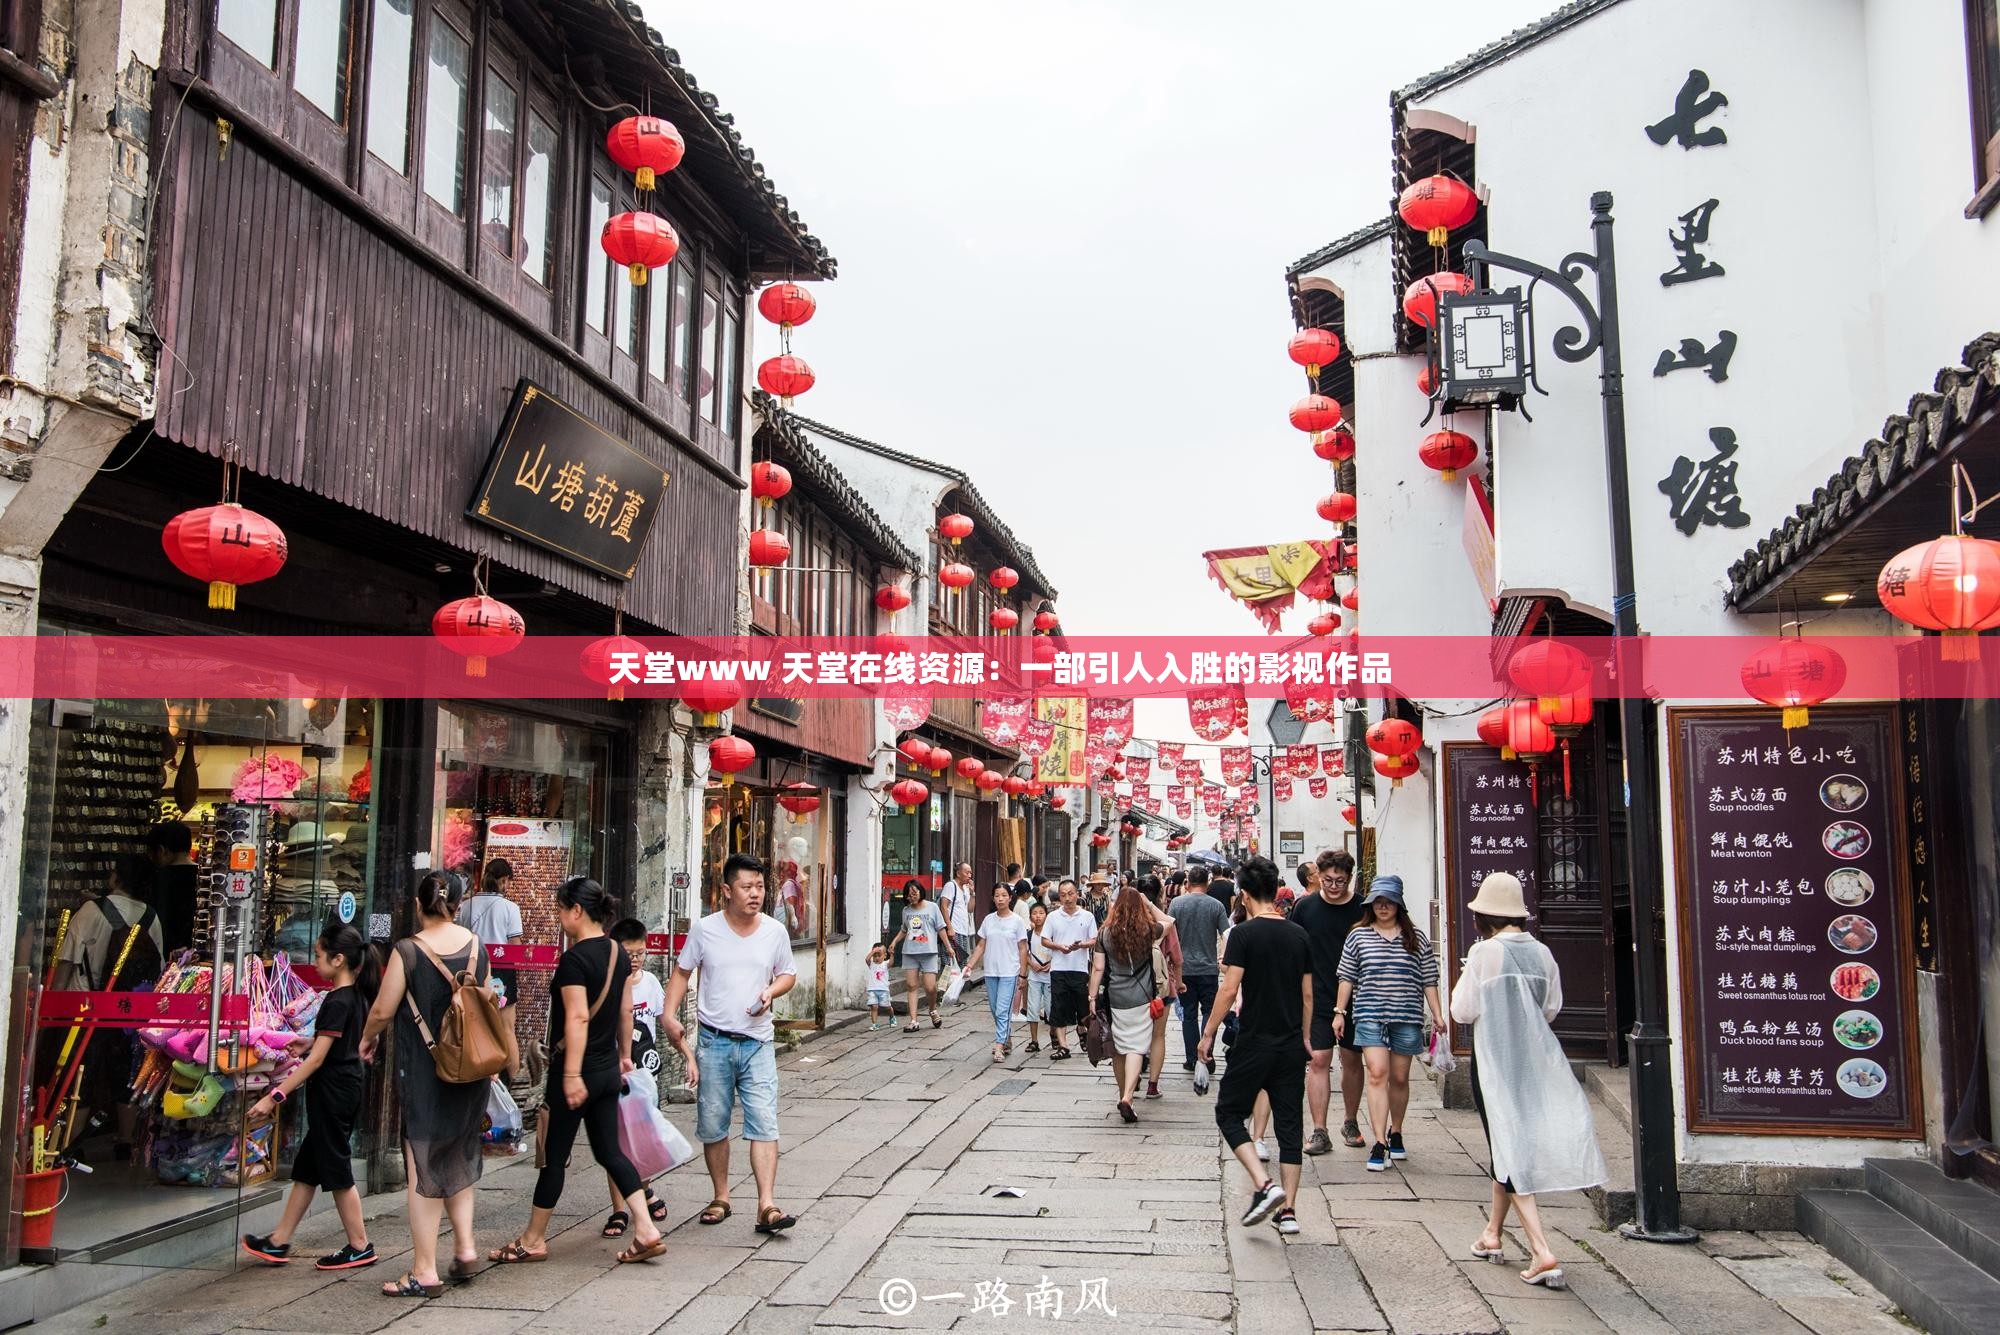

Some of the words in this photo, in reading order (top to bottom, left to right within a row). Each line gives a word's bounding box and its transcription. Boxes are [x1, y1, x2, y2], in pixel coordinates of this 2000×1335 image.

[1644, 68, 1751, 537] 七里山塘
[1884, 567, 1911, 597] 塘
[1717, 745, 1856, 765] 苏州特色小吃
[1709, 786, 1787, 802] 苏式汤面
[1469, 803, 1525, 815] 苏式汤面
[1709, 803, 1734, 812] Soup
[1736, 803, 1774, 811] noodles
[1470, 835, 1528, 848] 鲜肉馄饨
[1711, 832, 1793, 849] 鲜肉馄饨
[1711, 850, 1735, 858] Meat
[233, 878, 246, 892] 拉
[1713, 878, 1815, 896] 汤汁小笼包
[1713, 896, 1739, 904] Soup
[1740, 896, 1791, 905] dumplings
[1715, 925, 1796, 942] 苏式肉粽
[1715, 942, 1750, 951] Su-style
[1751, 943, 1772, 951] meat
[1773, 943, 1817, 953] dumplings
[1717, 972, 1798, 990] 桂花糖藕
[1718, 991, 1743, 1000] Sweet
[1744, 992, 1787, 1000] osmanthus
[1788, 992, 1808, 1000] lotus
[1809, 993, 1826, 1001] root
[1719, 1019, 1822, 1036] 鸭血粉丝汤
[1720, 1036, 1745, 1045] Duck
[1746, 1037, 1774, 1045] blood
[1776, 1037, 1798, 1046] fans
[1799, 1038, 1824, 1047] soup
[1722, 1085, 1776, 1094] Sweet-scented
[1776, 1086, 1817, 1095] osmanthus
[1817, 1087, 1833, 1096] taro
